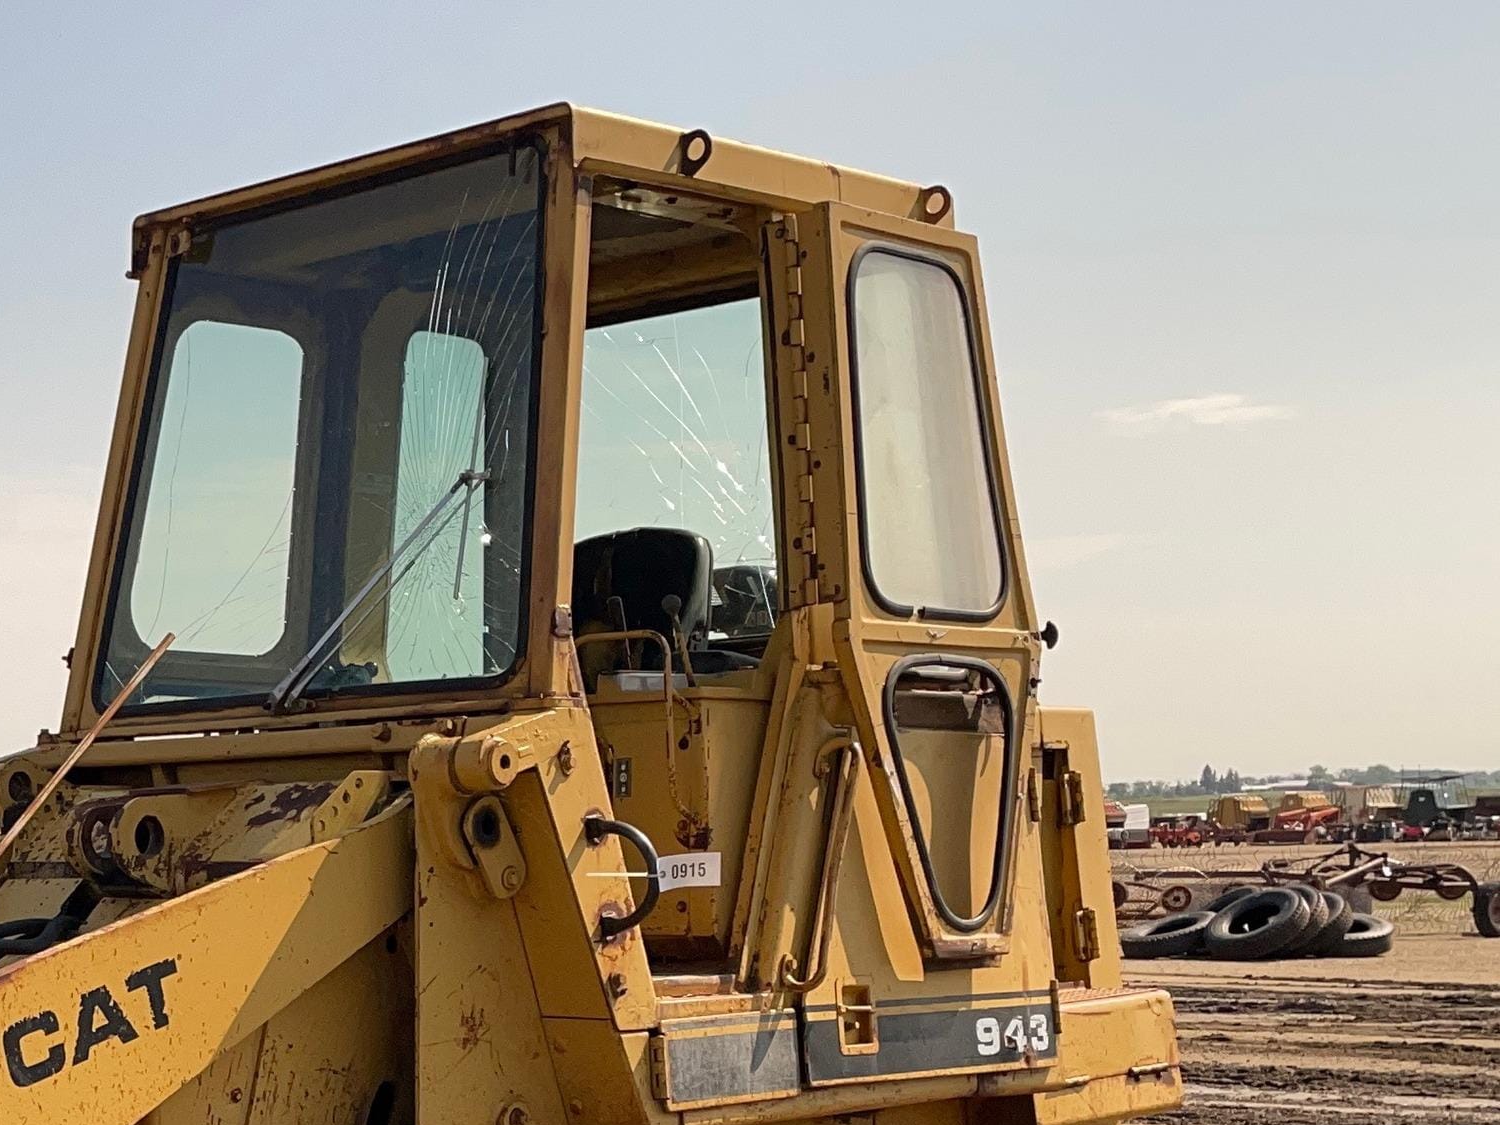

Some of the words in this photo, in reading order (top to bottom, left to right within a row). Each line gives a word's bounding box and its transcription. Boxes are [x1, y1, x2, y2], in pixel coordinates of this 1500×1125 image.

[671, 862, 706, 880] 0915
[2, 957, 178, 1088] CAT
[975, 1014, 1049, 1056] 943
